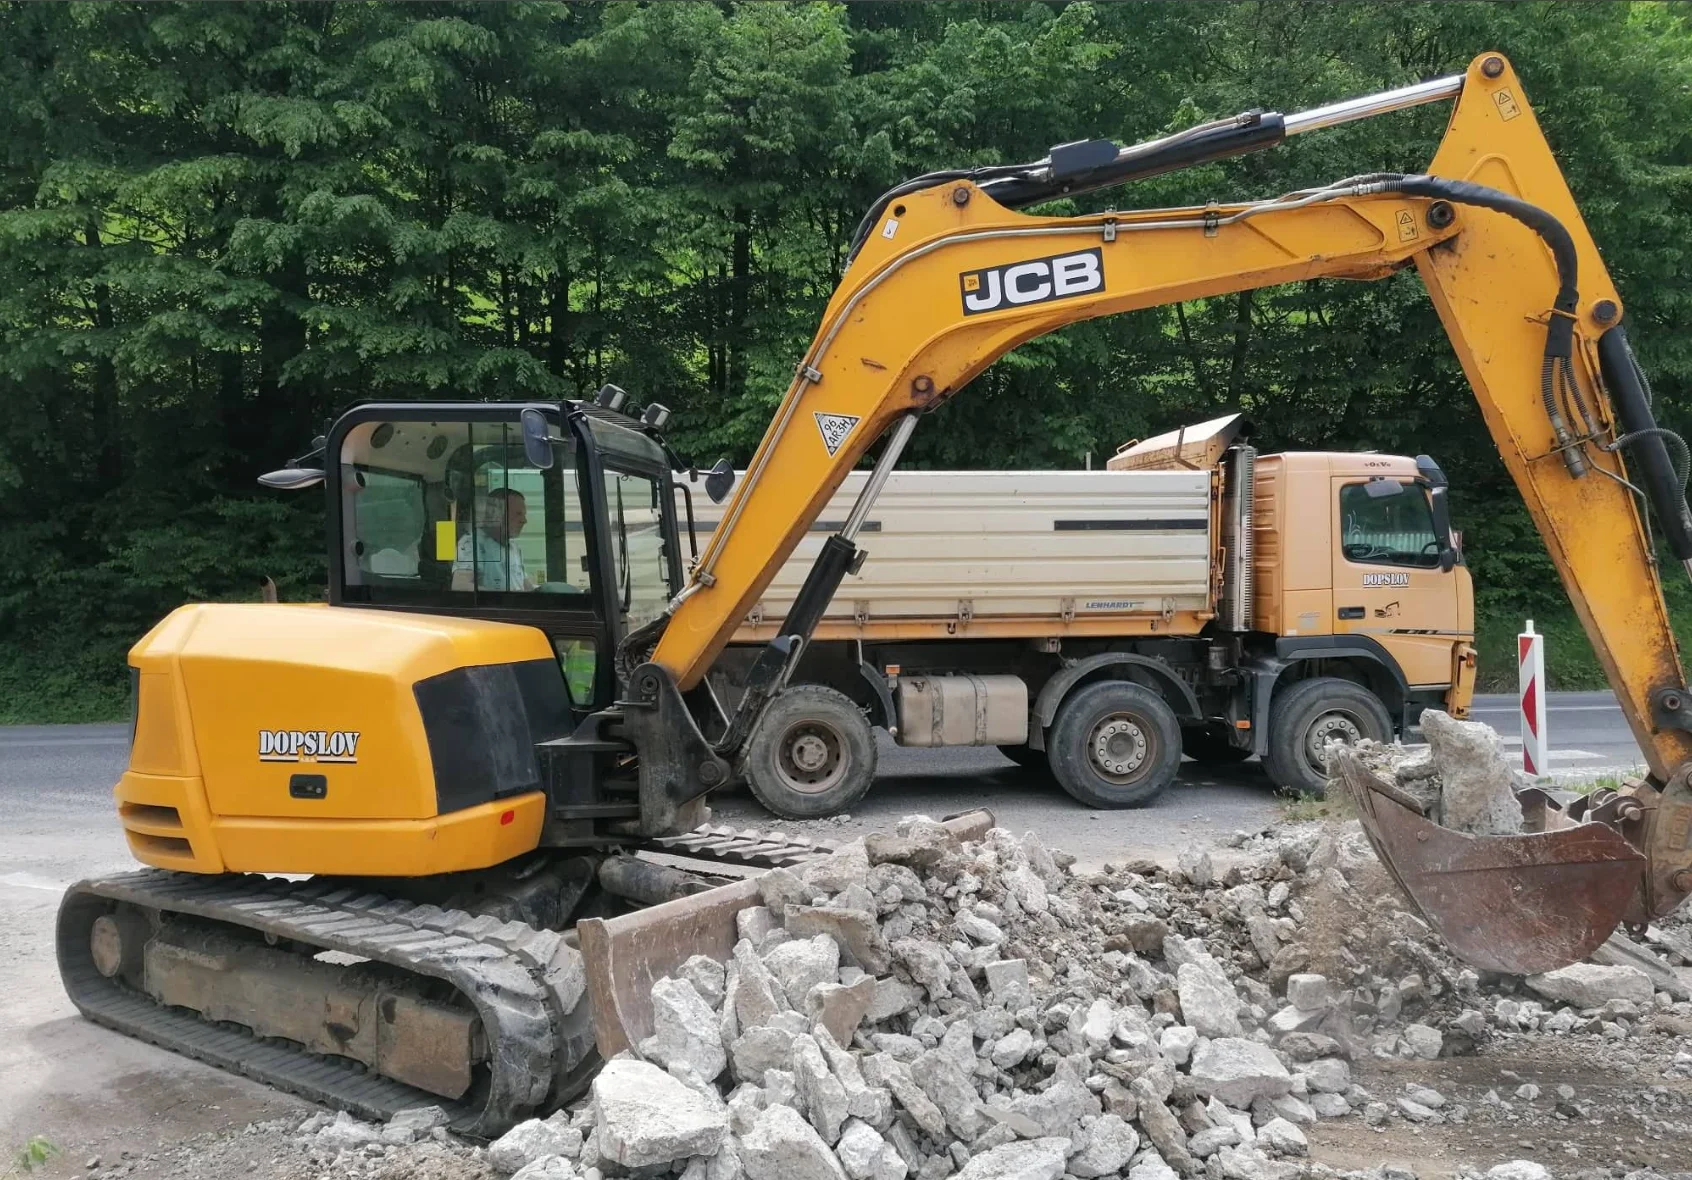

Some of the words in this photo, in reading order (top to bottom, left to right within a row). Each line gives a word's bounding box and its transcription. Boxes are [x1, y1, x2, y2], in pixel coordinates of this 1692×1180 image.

[965, 252, 1101, 311] JCB
[824, 419, 837, 432] 96
[828, 418, 850, 444] AR3H
[1363, 573, 1410, 585] DOPSLOV
[258, 730, 360, 756] DOPSLOV
